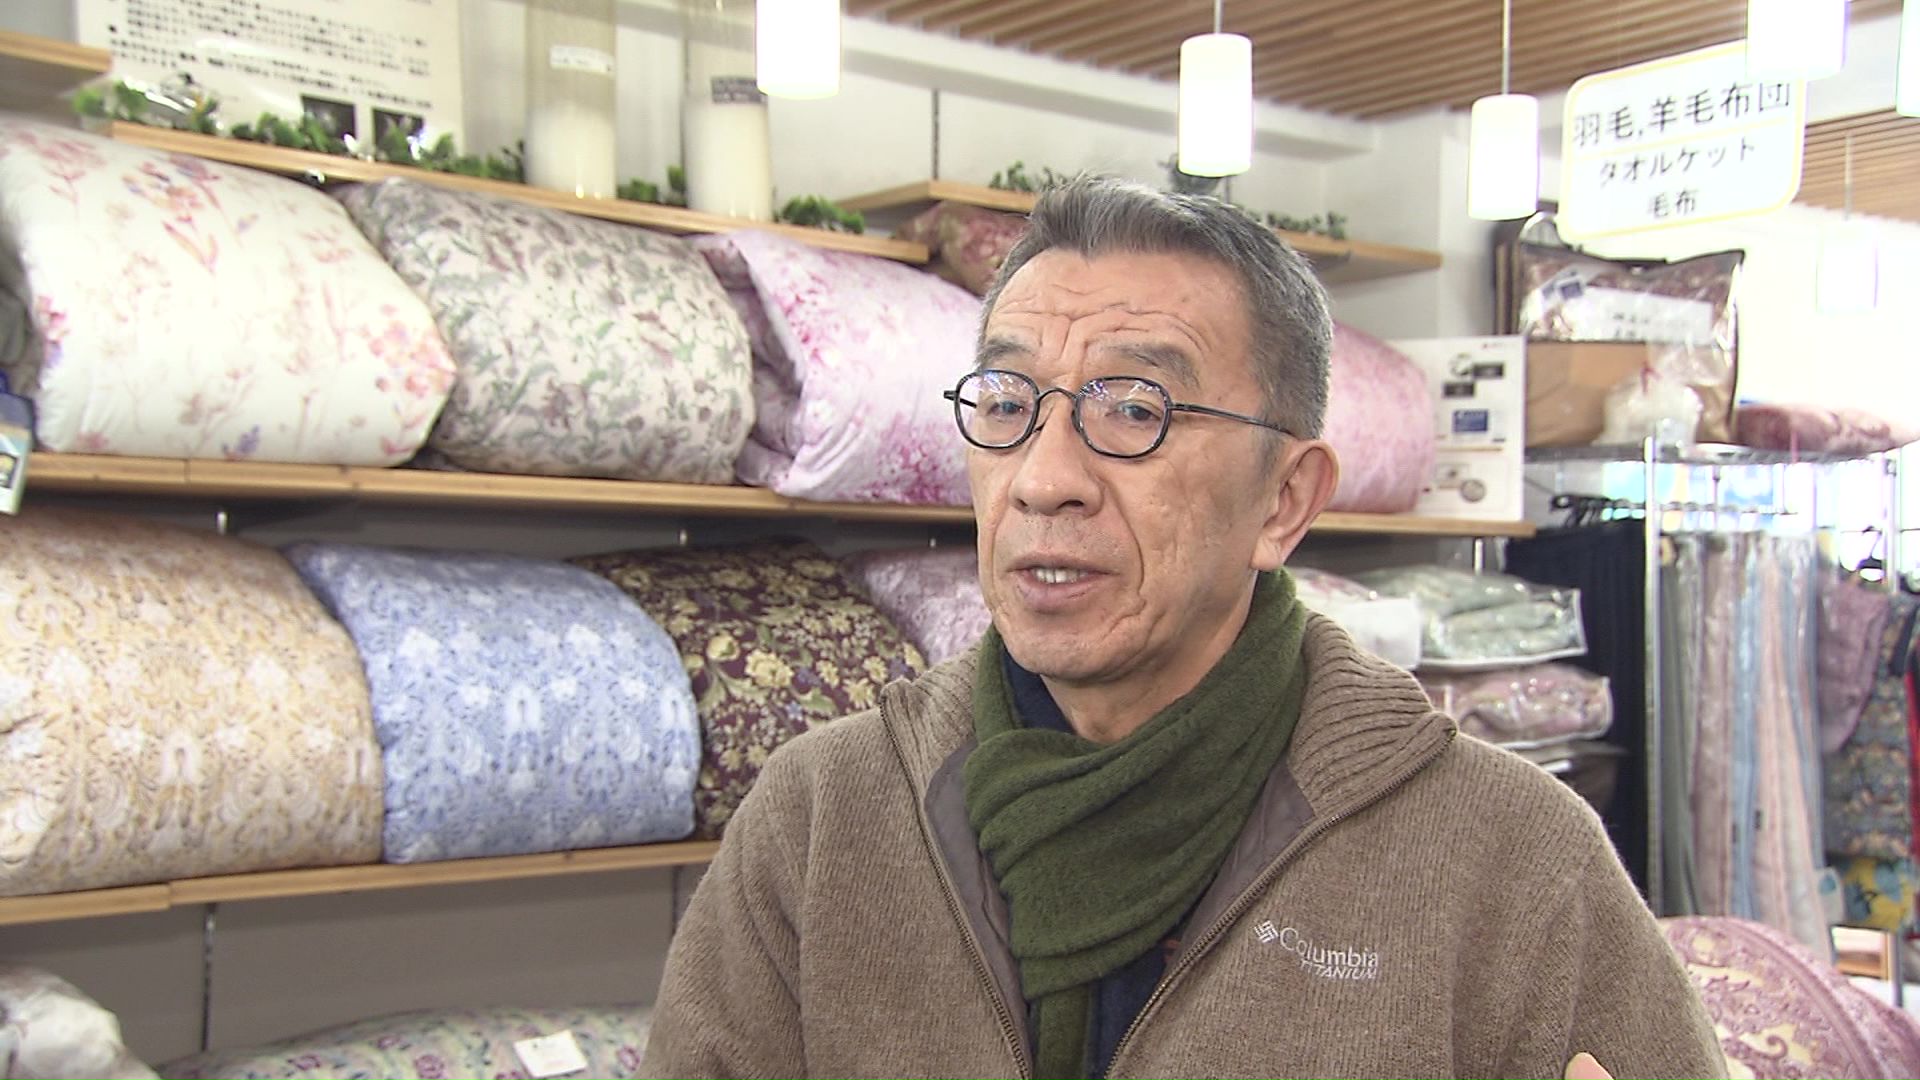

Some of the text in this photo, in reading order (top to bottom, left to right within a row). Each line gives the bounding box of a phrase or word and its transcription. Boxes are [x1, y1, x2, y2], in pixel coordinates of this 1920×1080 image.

[1600, 136, 1755, 187] タオルケット
[1650, 188, 1699, 218] 毛布
[1280, 927, 1379, 968] Columbia
[1300, 959, 1377, 980] TITANIUM
